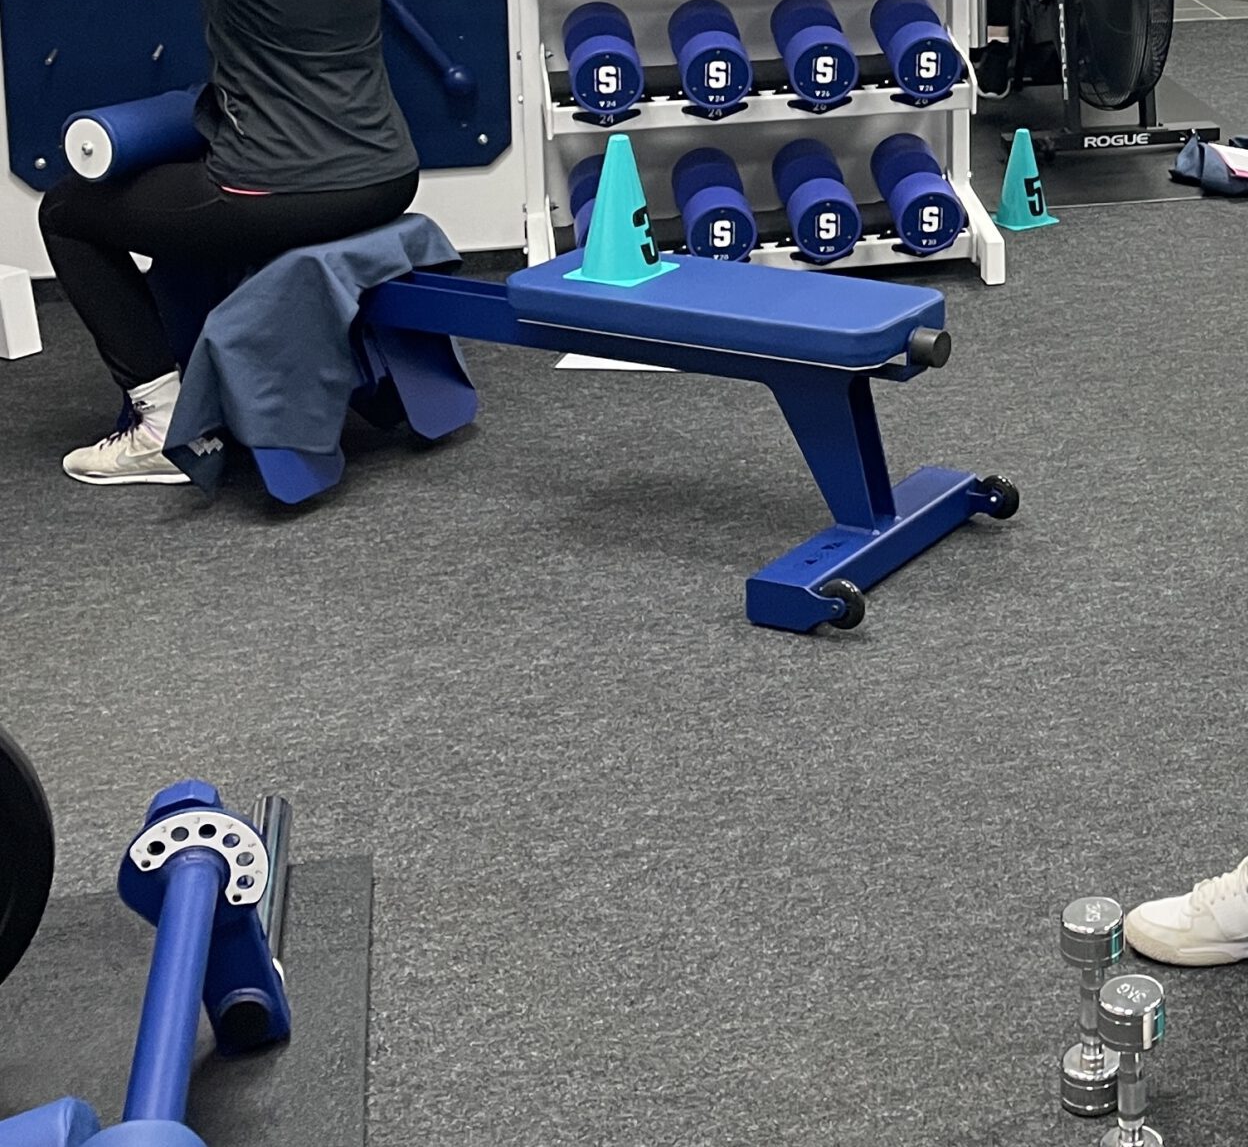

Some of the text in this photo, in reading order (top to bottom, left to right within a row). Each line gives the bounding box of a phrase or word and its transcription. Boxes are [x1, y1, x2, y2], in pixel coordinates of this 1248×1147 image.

[708, 61, 727, 89] S
[816, 56, 833, 83] S
[919, 51, 937, 78] S
[598, 65, 617, 94] S
[1083, 132, 1150, 148] ROGUE
[1024, 176, 1044, 217] 5
[819, 213, 836, 239] S
[922, 206, 939, 232] S
[632, 205, 659, 266] 3
[713, 220, 731, 247] S
